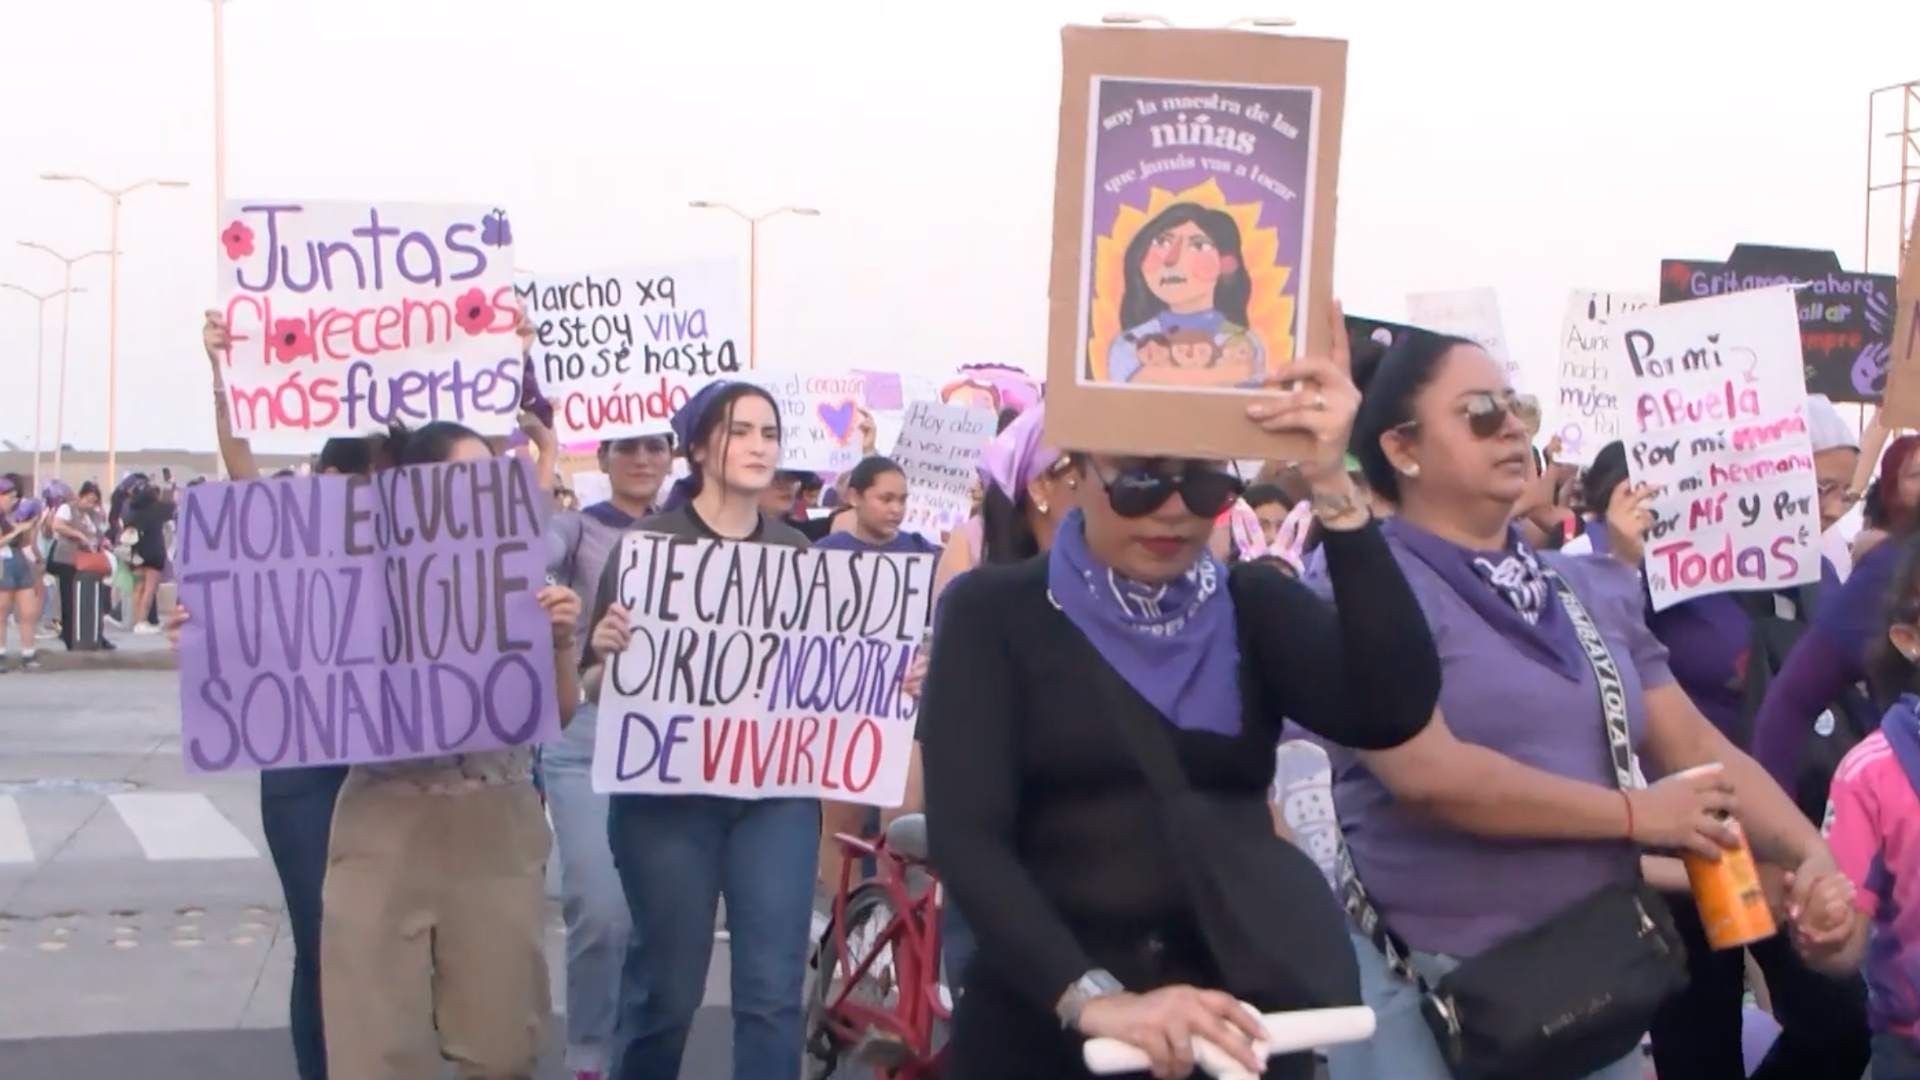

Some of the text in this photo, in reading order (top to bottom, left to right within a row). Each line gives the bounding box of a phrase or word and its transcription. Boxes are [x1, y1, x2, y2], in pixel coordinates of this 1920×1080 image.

[1102, 93, 1298, 140] soy la maestra de las
[1151, 113, 1256, 155] niñas
[1104, 168, 1136, 193] que
[1235, 163, 1247, 176] a
[236, 206, 488, 292] Juntas
[514, 276, 675, 311] Marcho xq
[1814, 273, 1873, 296] ahora
[537, 309, 708, 347] estoy viva
[545, 340, 741, 382] no sé hasta
[1625, 330, 1722, 377] Por mi
[231, 358, 521, 430] más fuertes
[565, 377, 689, 430] cuándo
[806, 377, 865, 395] corazón
[911, 404, 943, 434] Hoy
[1632, 440, 1679, 470] Por
[1691, 430, 1724, 456] mi
[1710, 455, 1812, 487] hermana
[345, 459, 540, 556] ESCUCHA
[1652, 533, 1798, 591] Todas
[383, 543, 532, 665] SIGUE
[190, 653, 542, 771] SONANDO
[617, 712, 883, 792] DE VIVIRLO
